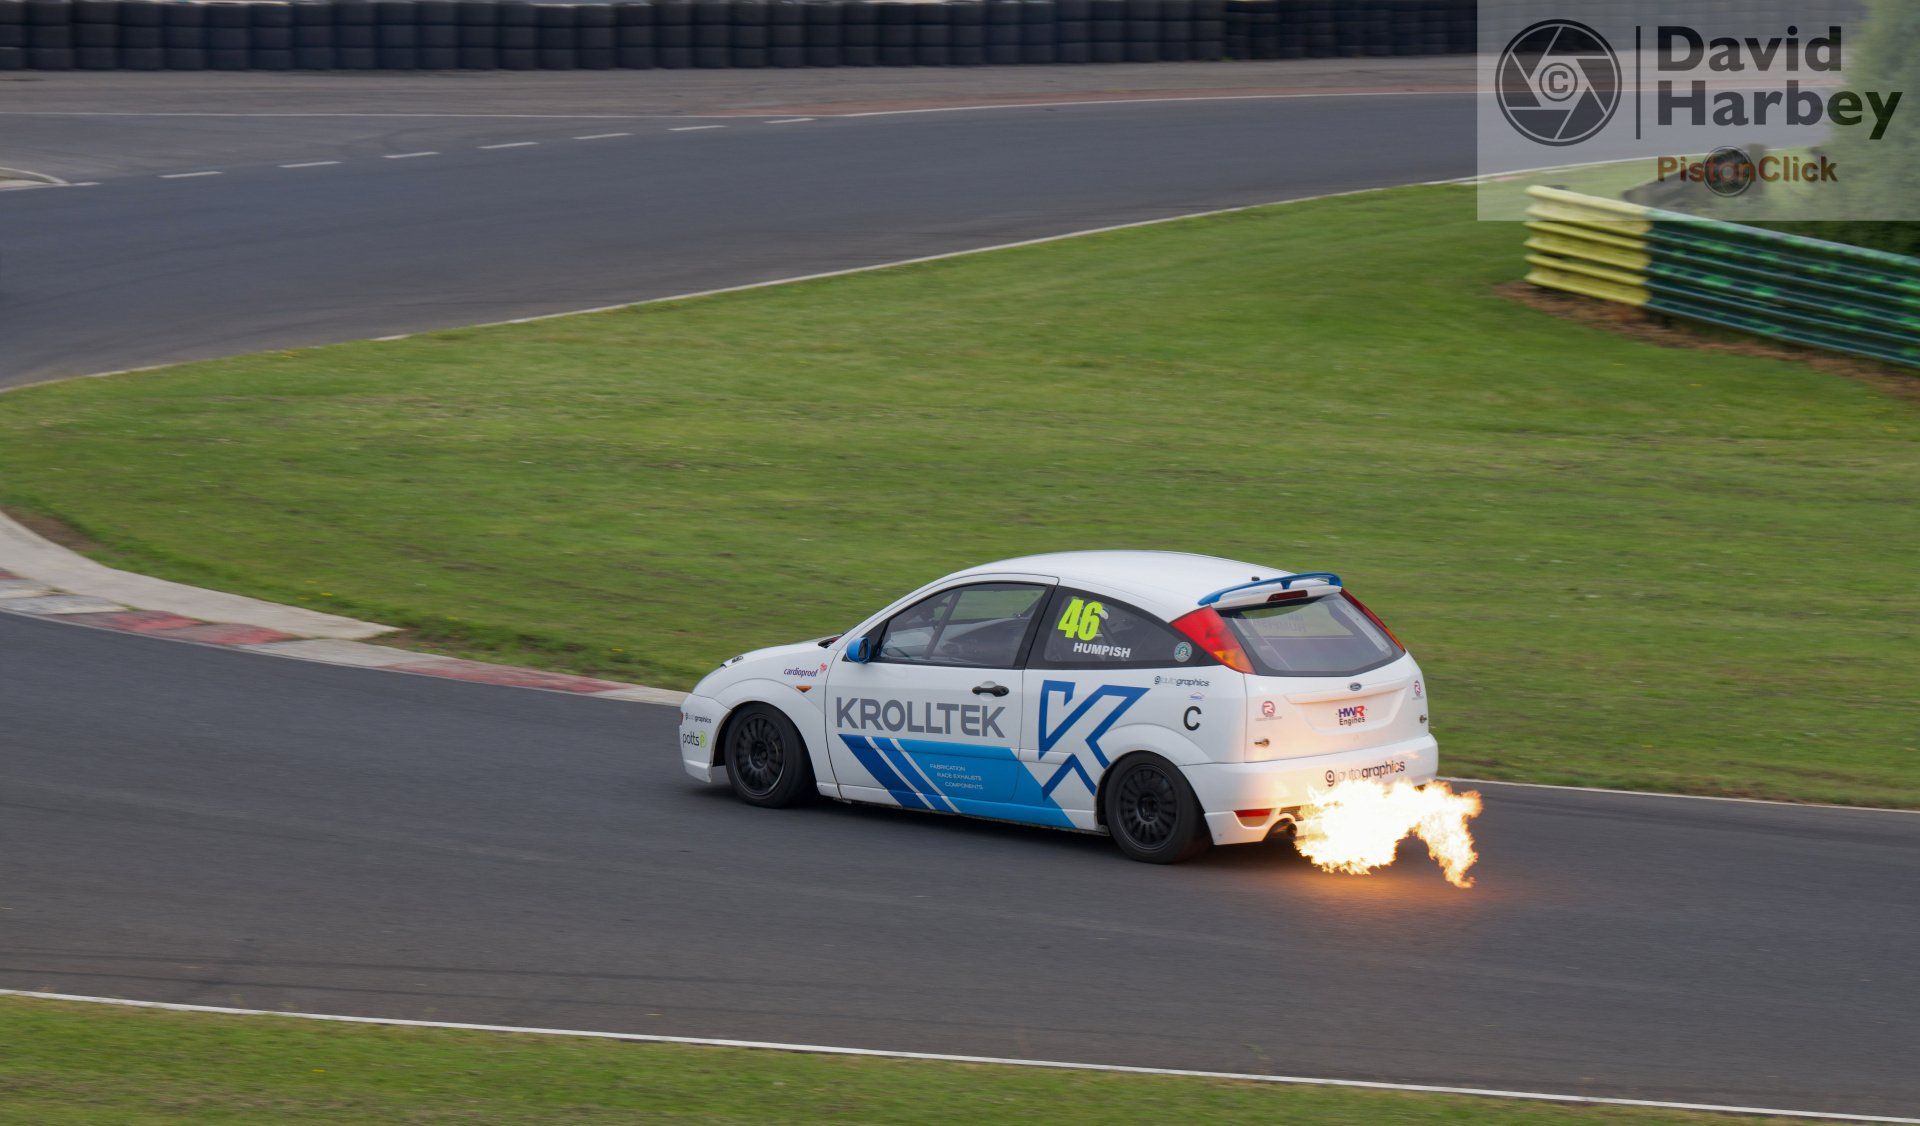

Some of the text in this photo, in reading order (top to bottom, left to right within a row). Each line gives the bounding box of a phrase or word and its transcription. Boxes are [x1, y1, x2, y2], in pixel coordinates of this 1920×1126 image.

[1057, 597, 1104, 641] 46
[1073, 642, 1131, 658] HUMPISH
[783, 667, 819, 678] cardioproof
[836, 696, 1006, 738] KROLLTEK
[1183, 705, 1202, 731] C
[1338, 705, 1365, 718] HWR
[1339, 717, 1366, 726] Engines
[682, 731, 700, 749] potts
[929, 763, 966, 771] FABRICATION
[953, 773, 982, 781] EXHAUSTS
[944, 781, 983, 790] COMPONENTS
